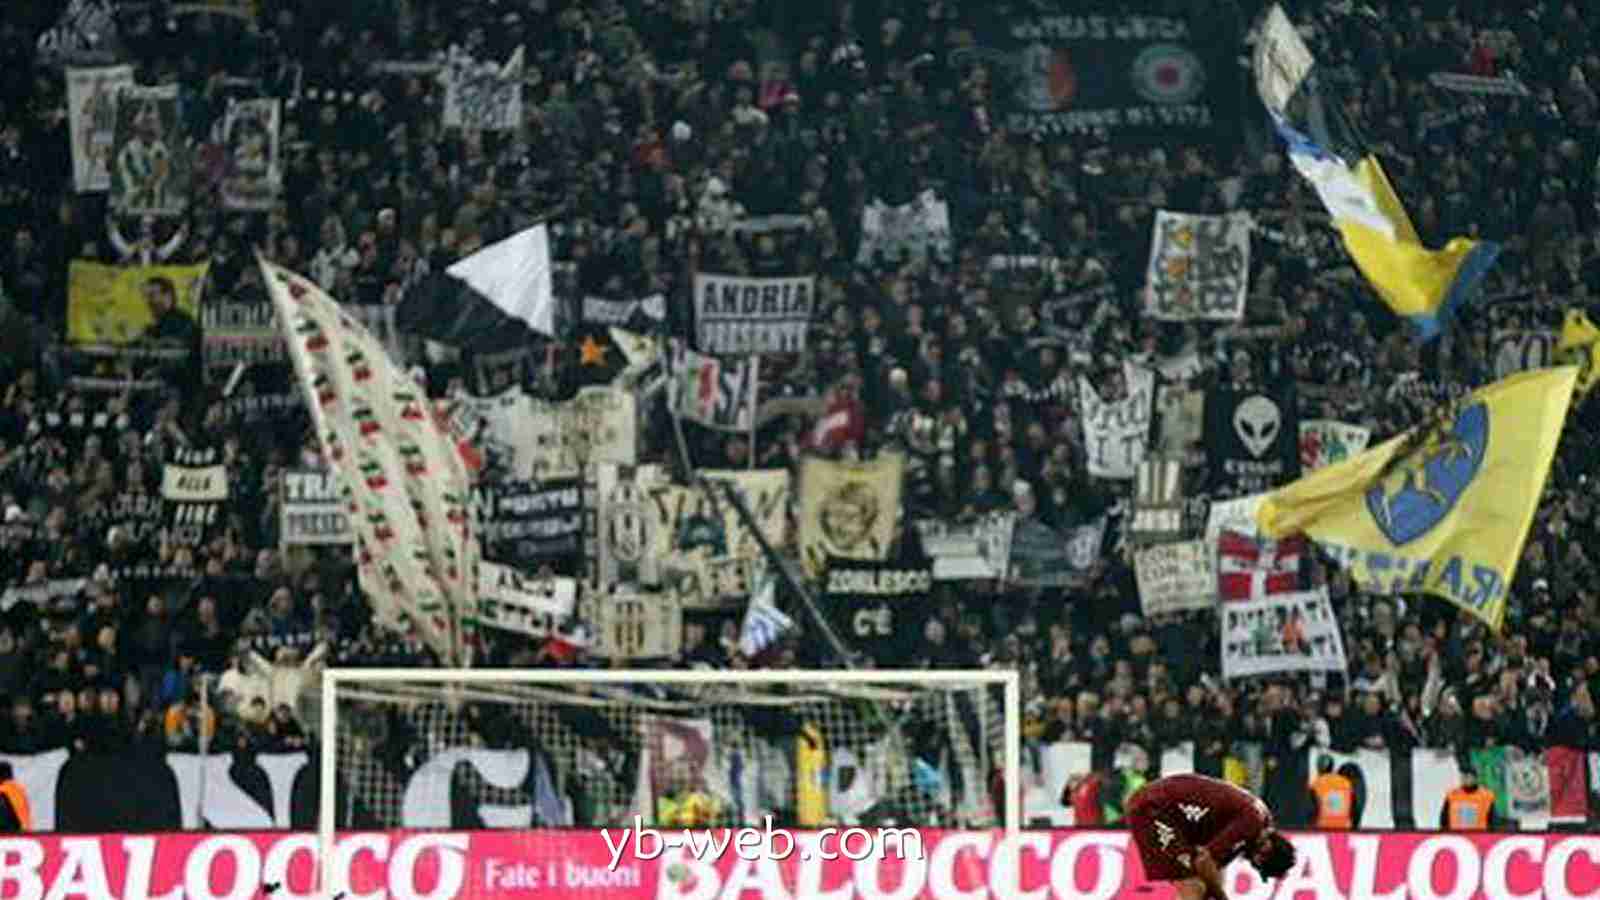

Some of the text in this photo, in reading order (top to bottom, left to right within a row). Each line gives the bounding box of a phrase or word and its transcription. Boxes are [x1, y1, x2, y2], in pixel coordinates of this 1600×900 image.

[703, 283, 810, 314] ANDRIA
[0, 833, 471, 900] BALOCCO
[484, 858, 539, 889] Fate
[564, 857, 642, 889] buoni
